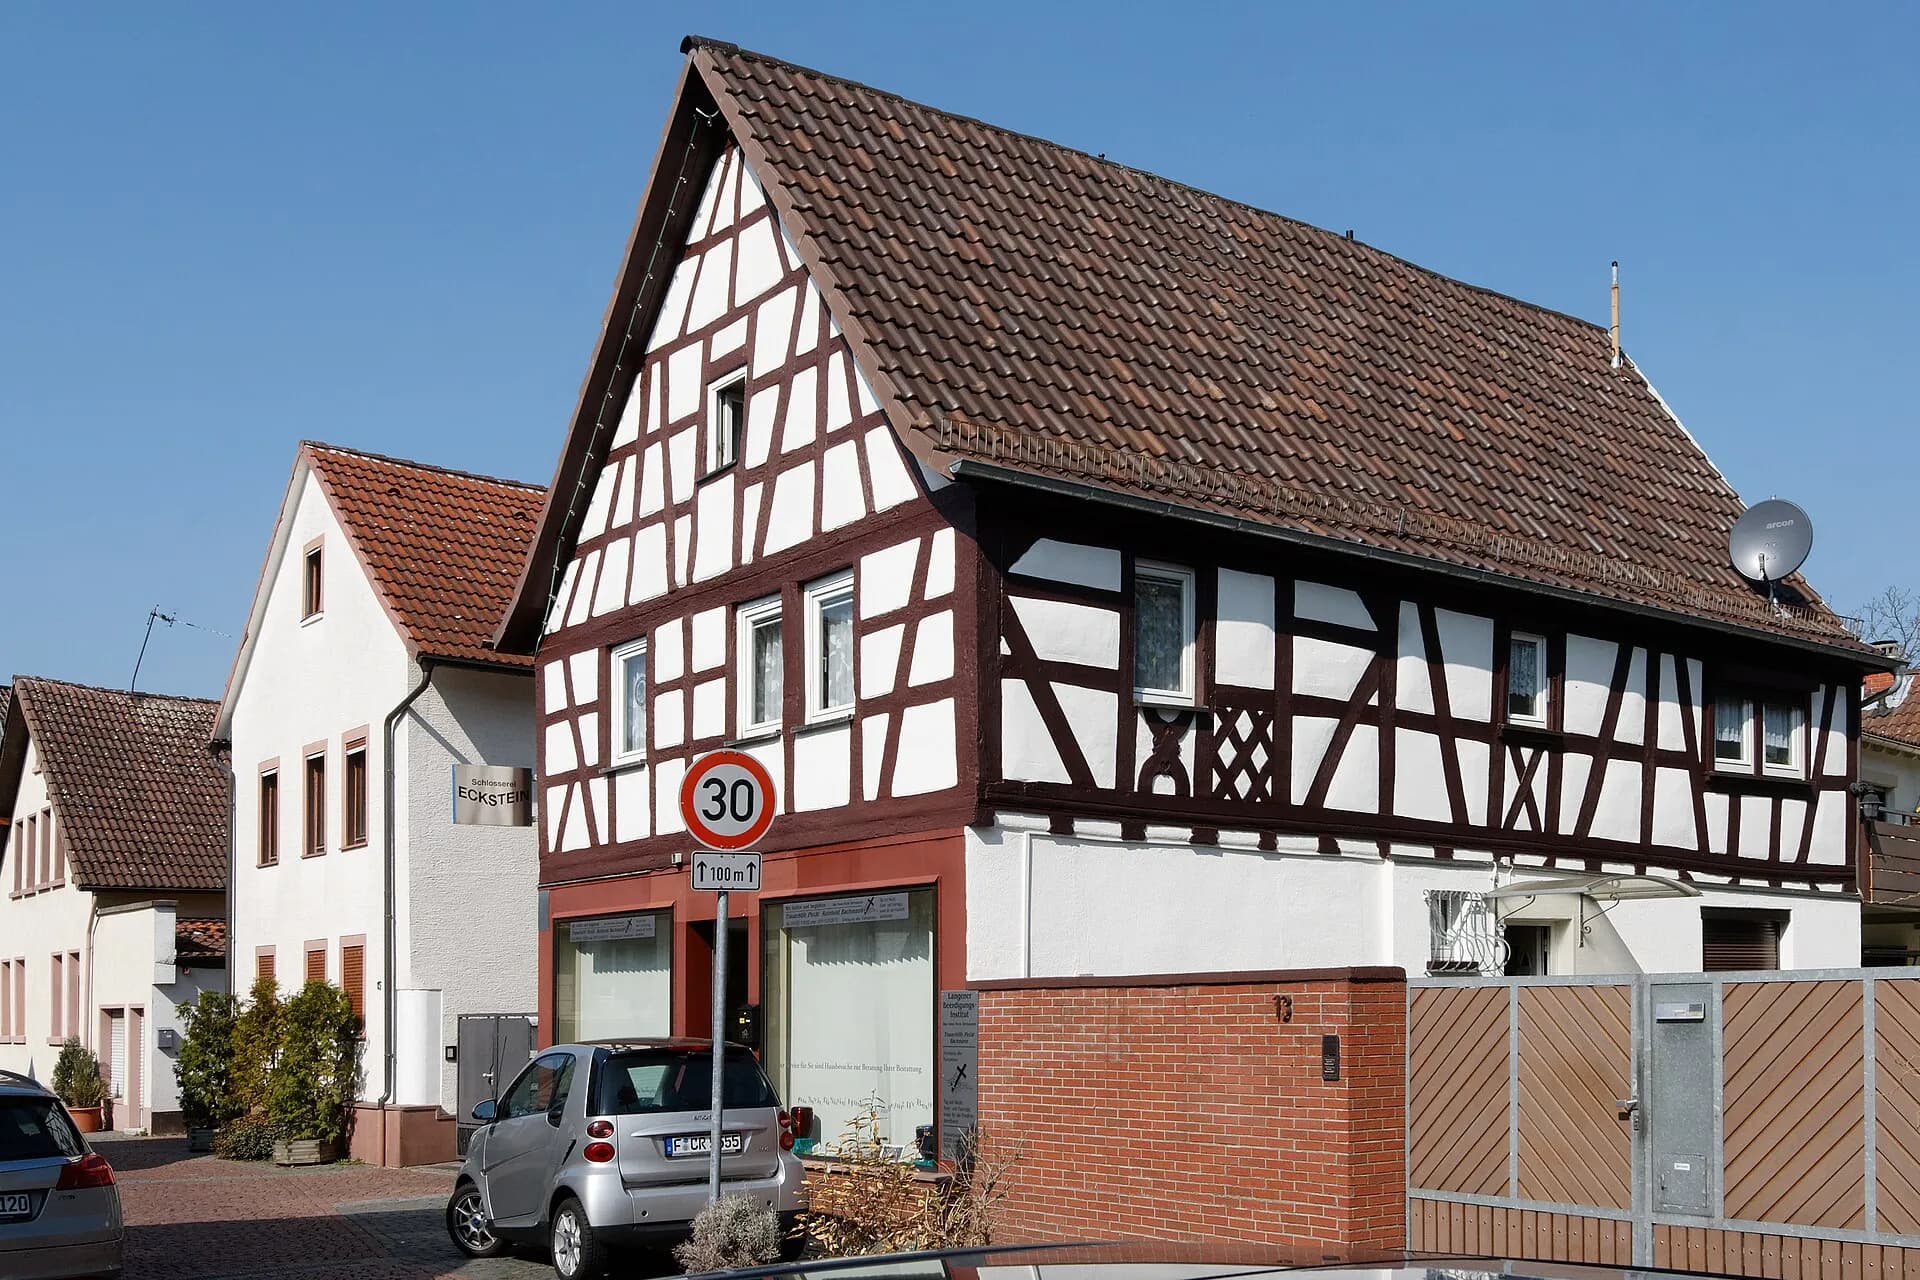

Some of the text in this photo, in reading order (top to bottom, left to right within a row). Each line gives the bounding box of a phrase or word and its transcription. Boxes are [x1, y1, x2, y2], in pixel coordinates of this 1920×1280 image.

[1766, 519, 1794, 529] arcon
[471, 778, 517, 788] Schlosserei
[458, 785, 530, 807] ECKSTEIN
[701, 777, 755, 822] 30
[710, 866, 744, 881] 100 m
[1272, 994, 1293, 1024] 13
[673, 1135, 739, 1152] F CR 555
